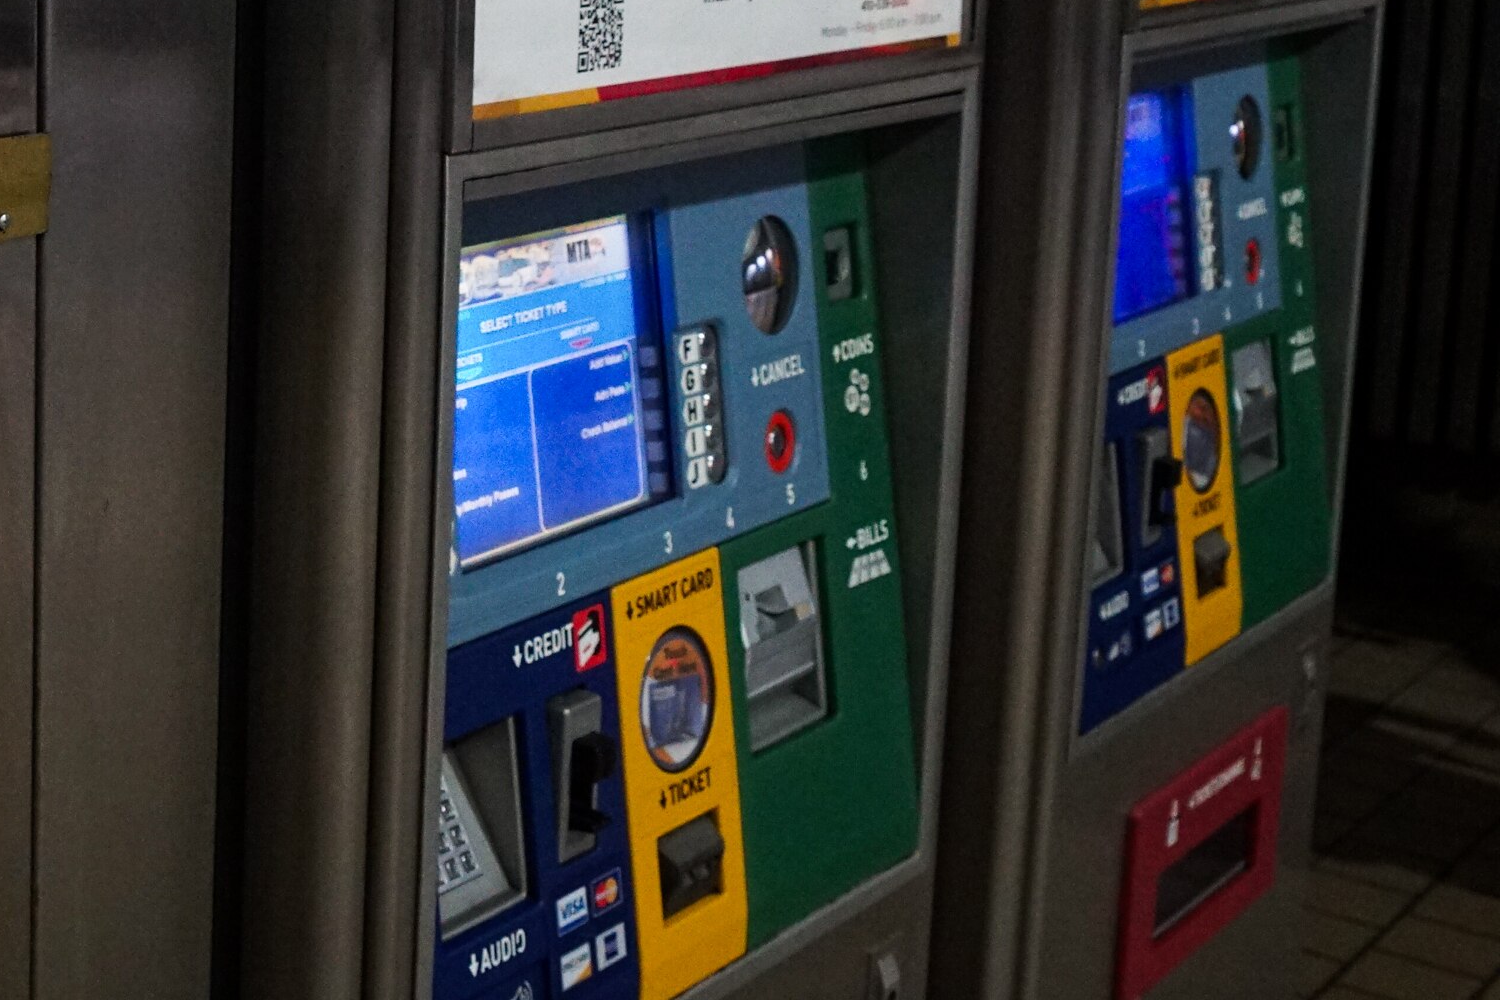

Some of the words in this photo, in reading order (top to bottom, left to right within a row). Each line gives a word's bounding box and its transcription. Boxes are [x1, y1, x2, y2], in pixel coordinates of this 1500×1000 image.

[567, 239, 591, 263] MTA
[480, 314, 512, 333] SELECT
[515, 307, 544, 324] TICKET
[546, 301, 567, 315] TYPE
[683, 339, 691, 360] F
[687, 371, 695, 390] G
[760, 354, 805, 385] CANCEL
[688, 402, 697, 421] H
[693, 464, 699, 483] J
[786, 483, 795, 505] 5
[664, 531, 673, 553] 3
[855, 520, 889, 549] BILLS
[556, 572, 565, 596] 2
[637, 582, 677, 618] SMART
[681, 568, 713, 599] CARD
[524, 622, 574, 664] CREDIT
[669, 766, 711, 805] TICKET
[481, 928, 526, 974] AUDIO
